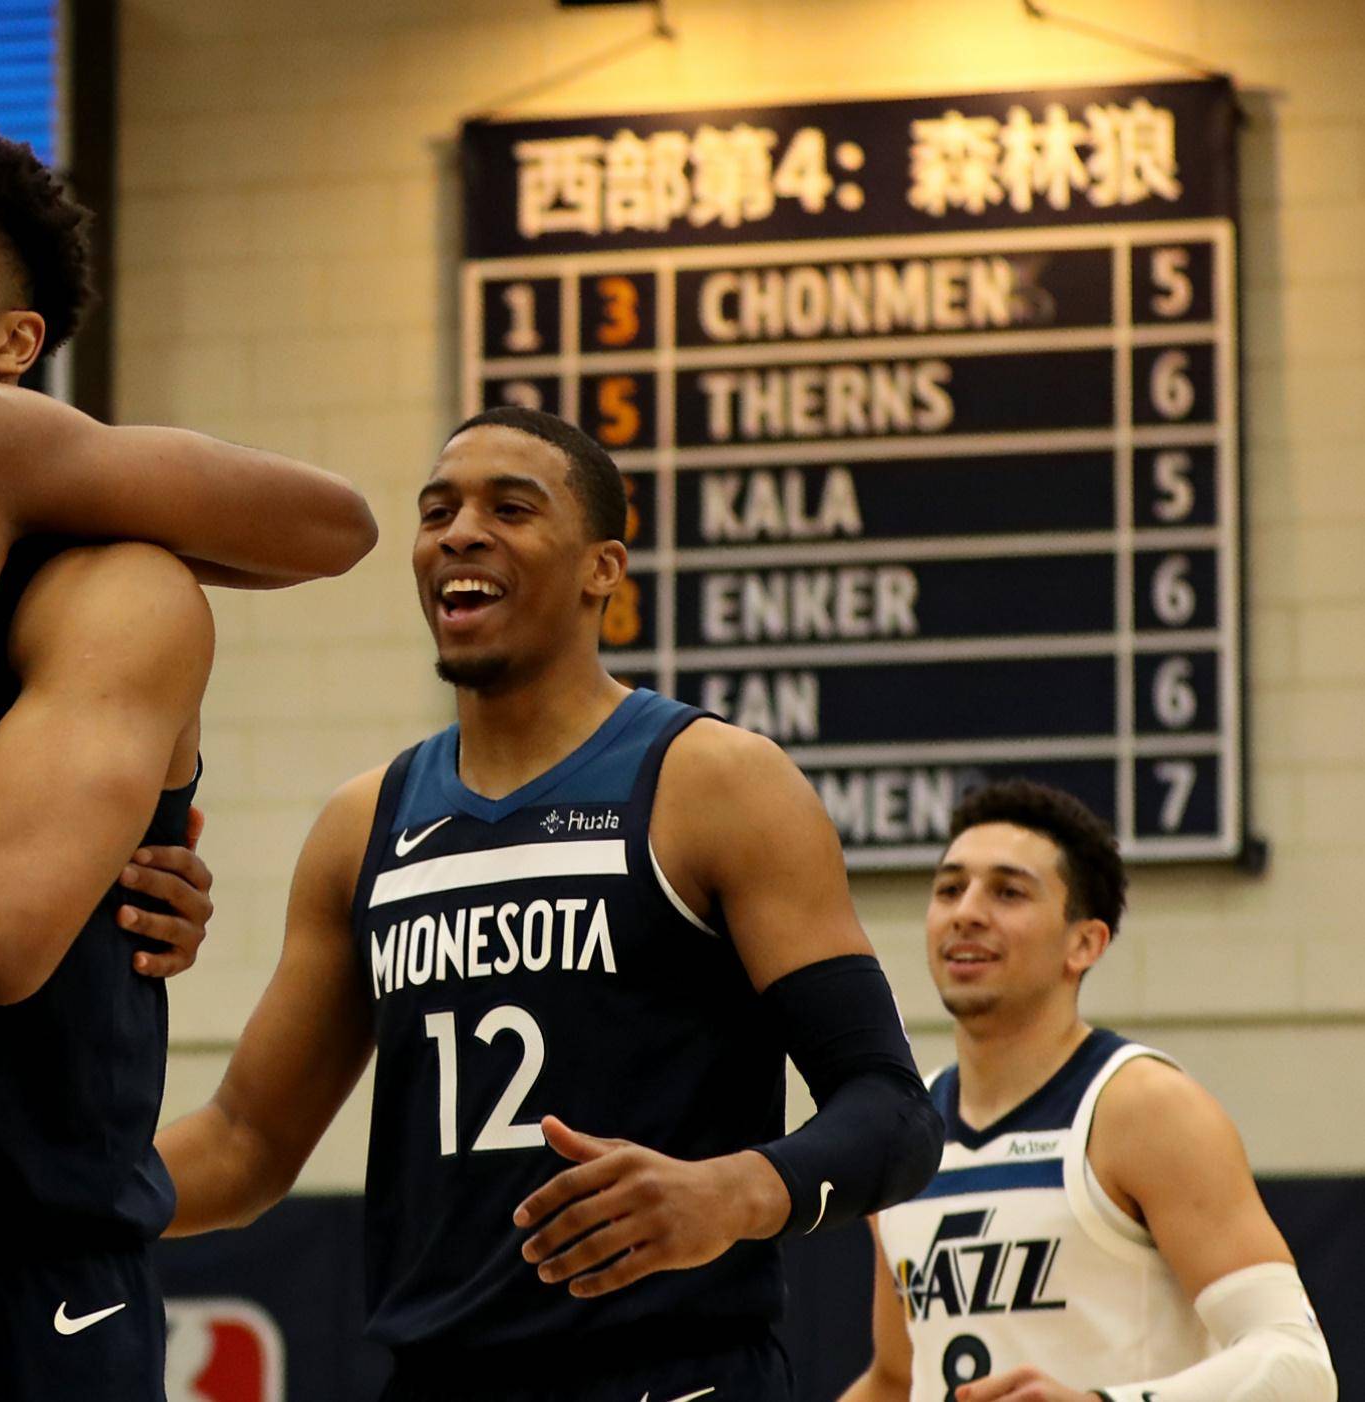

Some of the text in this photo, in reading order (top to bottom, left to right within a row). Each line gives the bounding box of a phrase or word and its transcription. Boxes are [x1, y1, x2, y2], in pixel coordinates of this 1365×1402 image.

[596, 275, 640, 347] 3
[698, 256, 1014, 342] CHONMEN
[1150, 247, 1194, 318] 5
[596, 377, 640, 446] 5
[699, 361, 954, 443] THERNS
[1149, 351, 1195, 420] 6
[699, 464, 865, 542] KALA
[1151, 452, 1195, 522] 5
[702, 565, 920, 643] ENKER
[1150, 554, 1196, 626] 6
[1151, 655, 1197, 728] 6
[1153, 759, 1197, 832] 7
[370, 897, 618, 1000] MIONESOTA
[425, 1004, 547, 1157] 12
